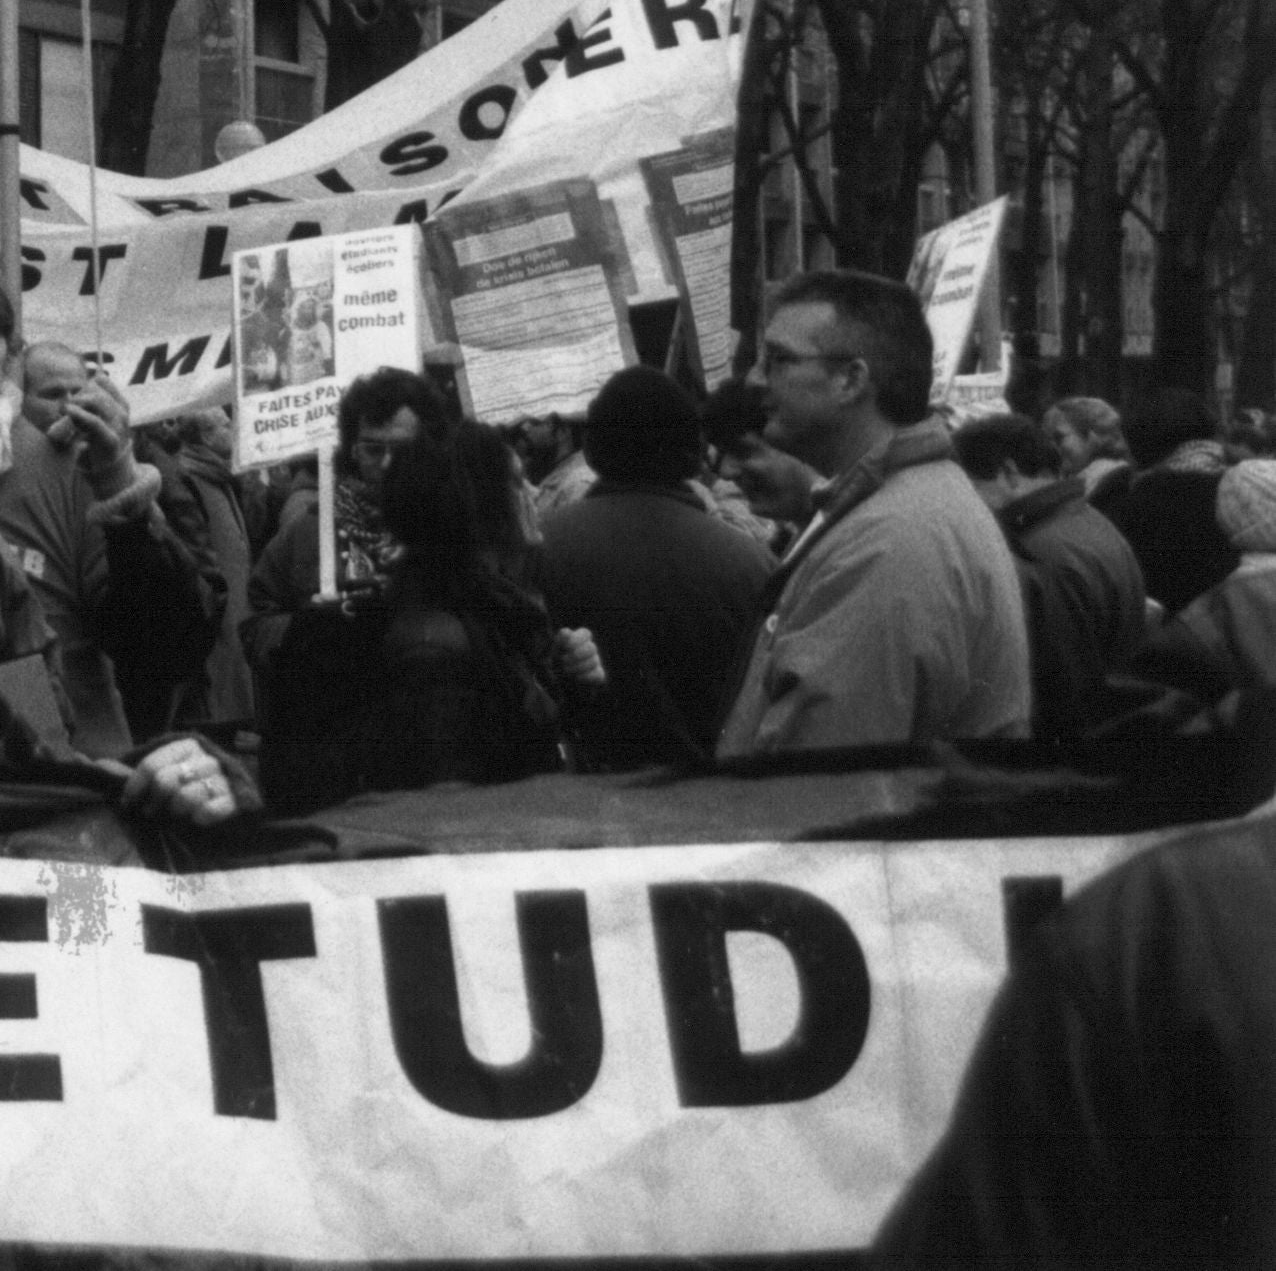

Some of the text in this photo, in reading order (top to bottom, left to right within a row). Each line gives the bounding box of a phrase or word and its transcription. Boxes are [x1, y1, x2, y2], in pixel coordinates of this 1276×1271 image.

[343, 287, 399, 307] même
[338, 311, 406, 333] combat
[258, 383, 348, 415] FAITES PAY
[253, 412, 300, 436] CRISE
[303, 401, 337, 424] AUX
